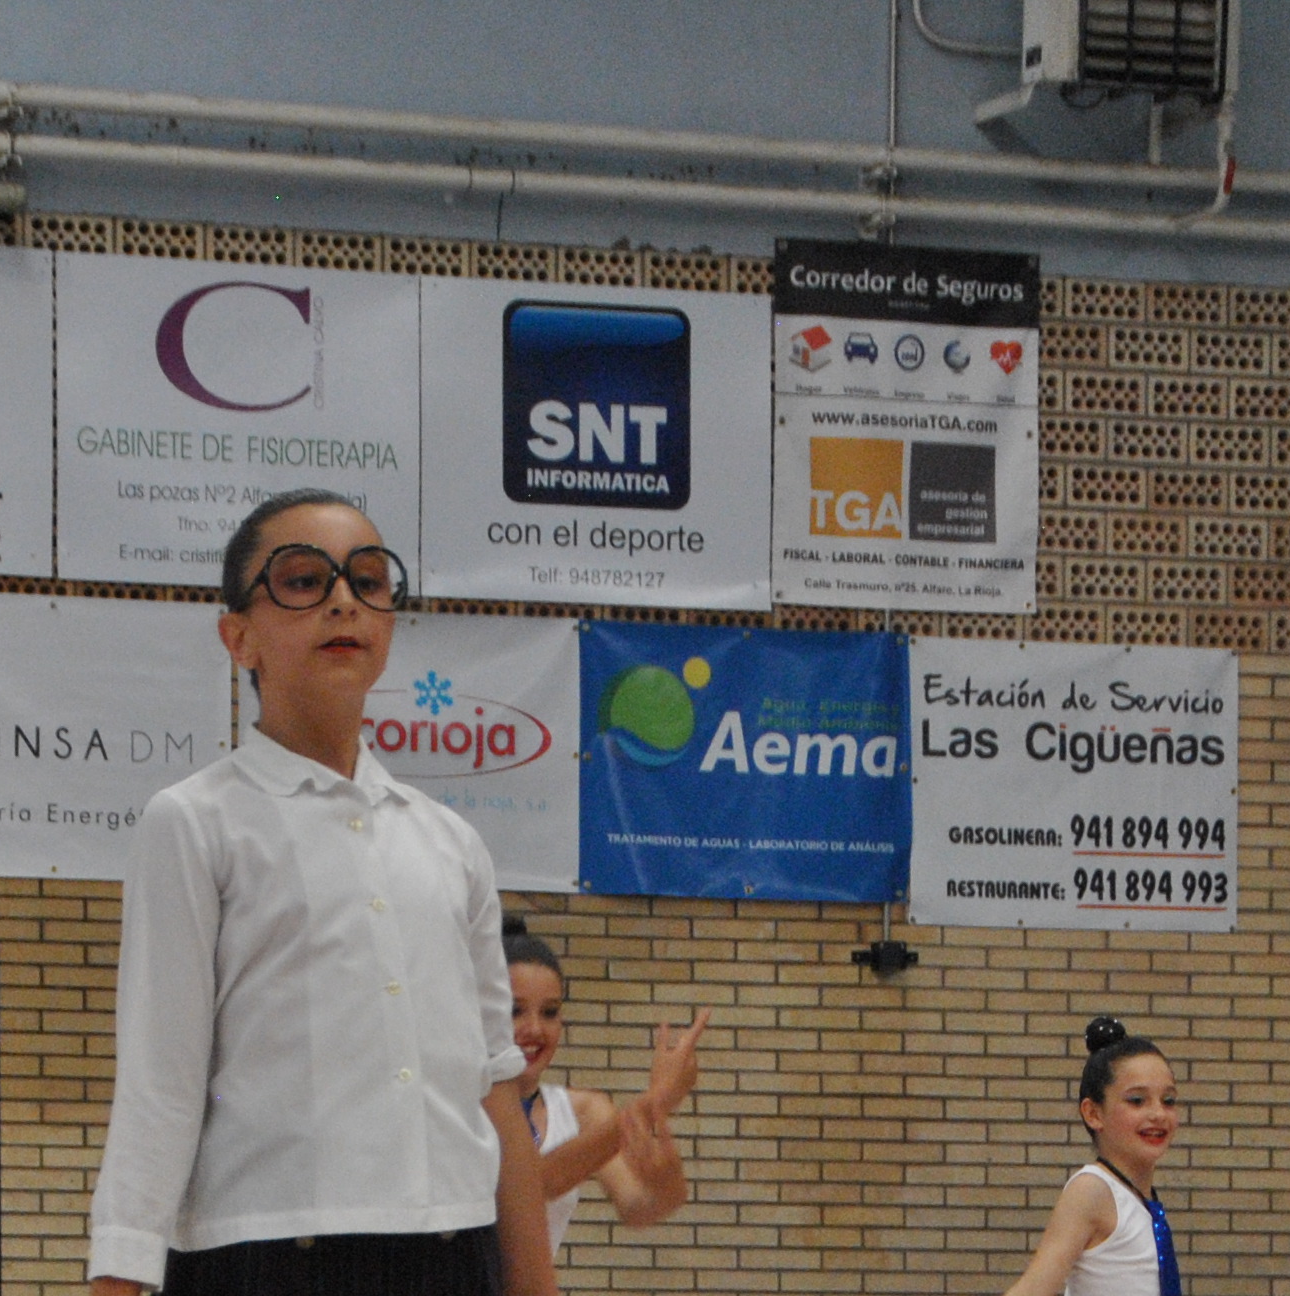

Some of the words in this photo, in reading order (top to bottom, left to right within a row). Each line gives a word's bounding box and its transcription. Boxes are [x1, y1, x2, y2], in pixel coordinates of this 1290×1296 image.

[789, 264, 897, 294] Corredor
[902, 271, 929, 293] de
[936, 273, 1025, 305] Seguros
[155, 281, 311, 412] C
[527, 399, 668, 466] SNT
[811, 411, 999, 434] www.asesoriaTGA.com
[76, 426, 192, 461] GABINETE
[202, 432, 233, 463] DE
[247, 436, 399, 471] FISIOTERAPIA
[117, 480, 144, 498] Las
[150, 486, 200, 506] pozas
[526, 467, 670, 495] INFORMATICA
[810, 488, 902, 532] TGA
[487, 522, 541, 546] con
[553, 519, 578, 547] el
[589, 521, 704, 556] deporte
[917, 522, 985, 536] empresarial
[119, 543, 174, 562] E-mail:
[783, 548, 822, 562] FISCAL
[832, 551, 886, 565] LABORAL
[895, 554, 949, 568] CONTABLE
[958, 557, 1025, 570] FINANCIERA
[568, 567, 666, 589] 948782127
[923, 673, 1046, 711] Estación
[1061, 680, 1097, 711] de
[1109, 681, 1224, 715] Servicio
[130, 730, 194, 764] DM
[699, 710, 898, 778] Aema
[921, 717, 999, 760] Las
[1025, 721, 1226, 774] Cigüeñas
[47, 803, 146, 831] Energé
[948, 825, 1063, 848] GASOLINERA:
[1070, 814, 1113, 849] 941
[1122, 816, 1170, 850] 894
[1178, 817, 1226, 852] 994
[607, 833, 681, 847] TRATAMIENTO
[684, 837, 698, 848] DE
[701, 838, 740, 849] AGUAS
[749, 840, 828, 851] LABORATORIO
[831, 841, 845, 852] DE
[946, 879, 1066, 901] RESTAURANTE:
[1073, 867, 1117, 901] 941
[1125, 869, 1172, 903] 894
[1181, 870, 1229, 905] 993
